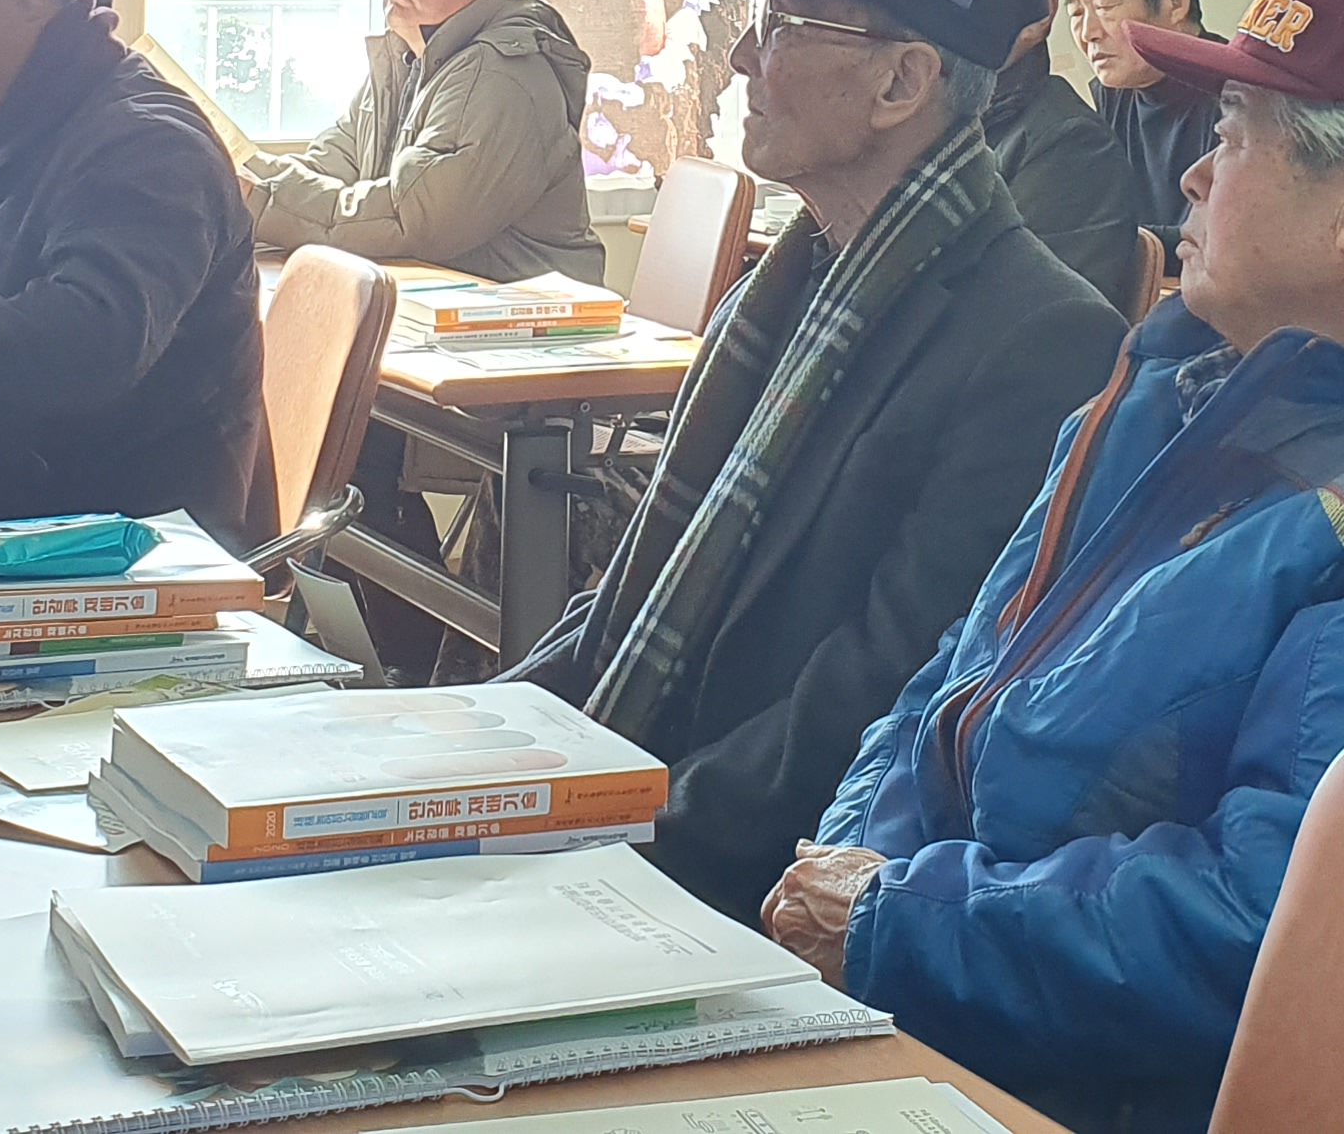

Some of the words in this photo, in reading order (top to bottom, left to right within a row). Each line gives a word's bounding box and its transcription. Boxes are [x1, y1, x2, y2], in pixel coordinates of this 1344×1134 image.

[265, 810, 277, 838] 2020
[408, 798, 461, 820] 만감류
[468, 791, 537, 815] 재배기술
